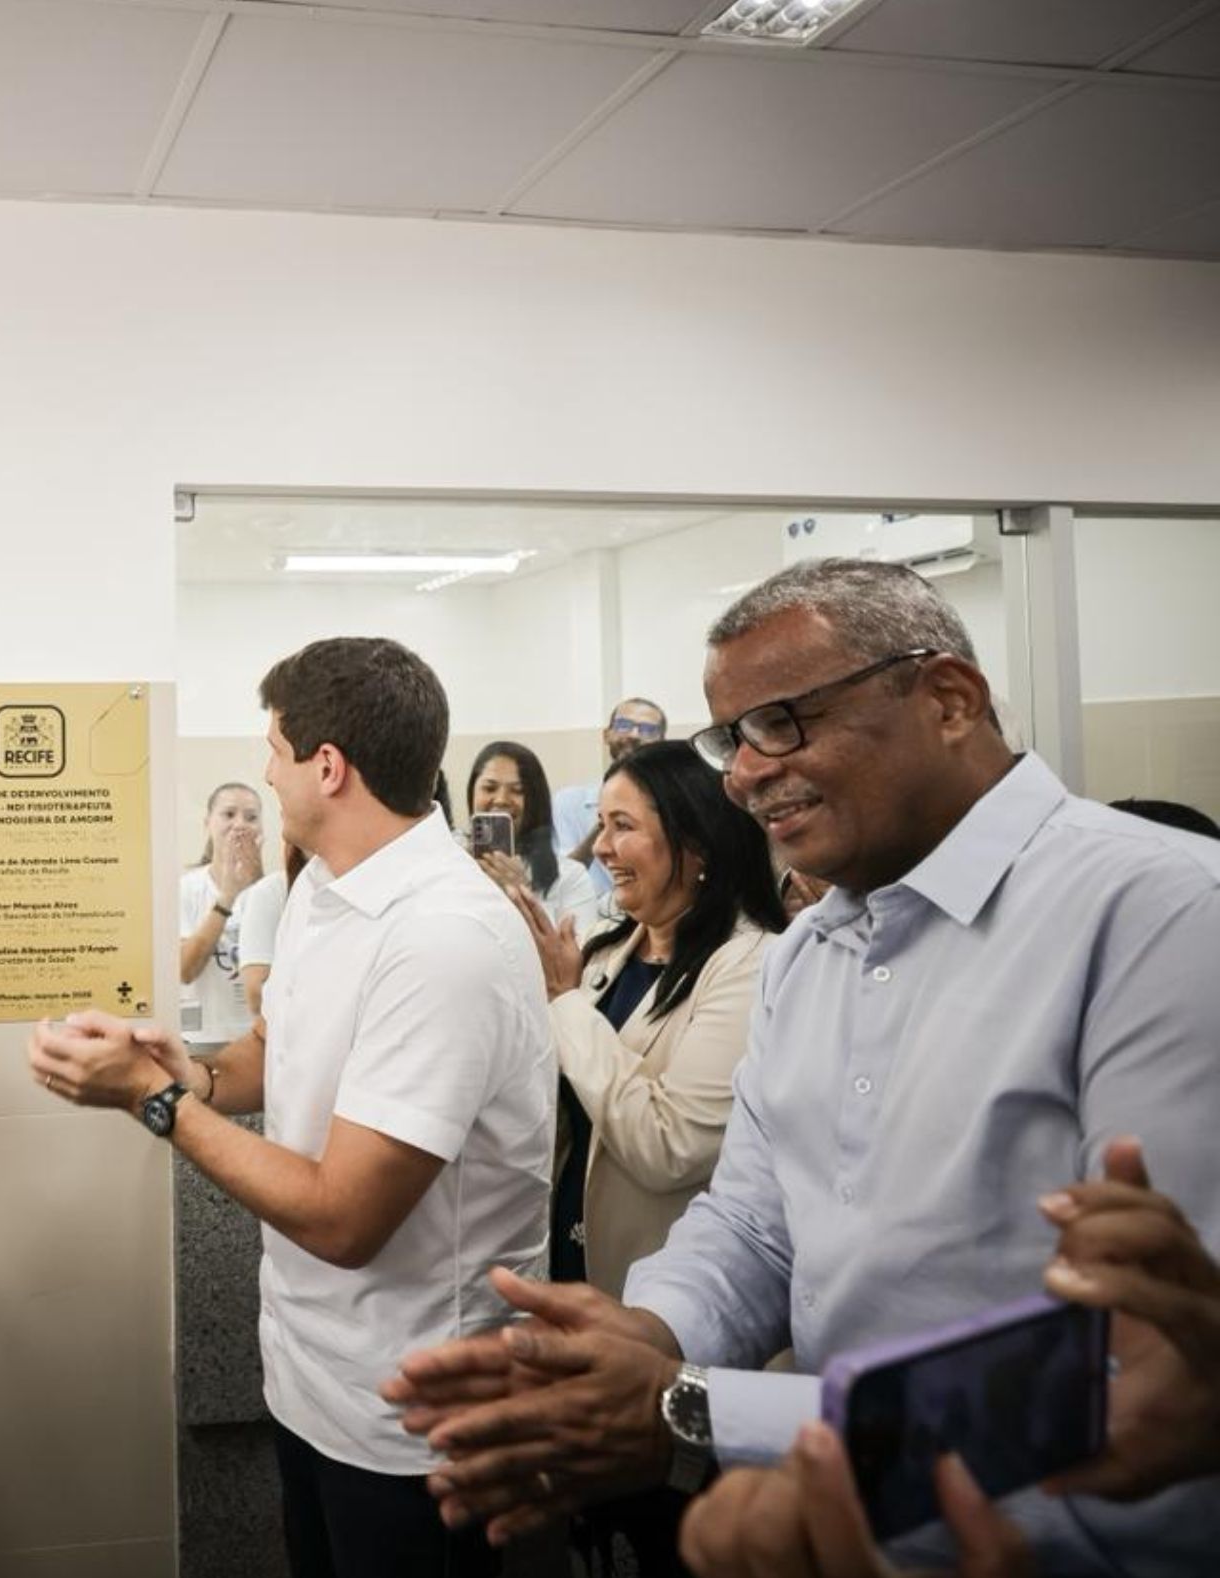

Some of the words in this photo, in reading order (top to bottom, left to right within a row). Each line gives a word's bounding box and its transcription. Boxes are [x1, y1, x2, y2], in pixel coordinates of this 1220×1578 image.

[5, 750, 55, 764] RECIFE
[10, 790, 110, 799] DESENVOLVIMENTO
[28, 802, 112, 811] FISIOTERAPEUTA
[70, 816, 113, 824] AMORIM
